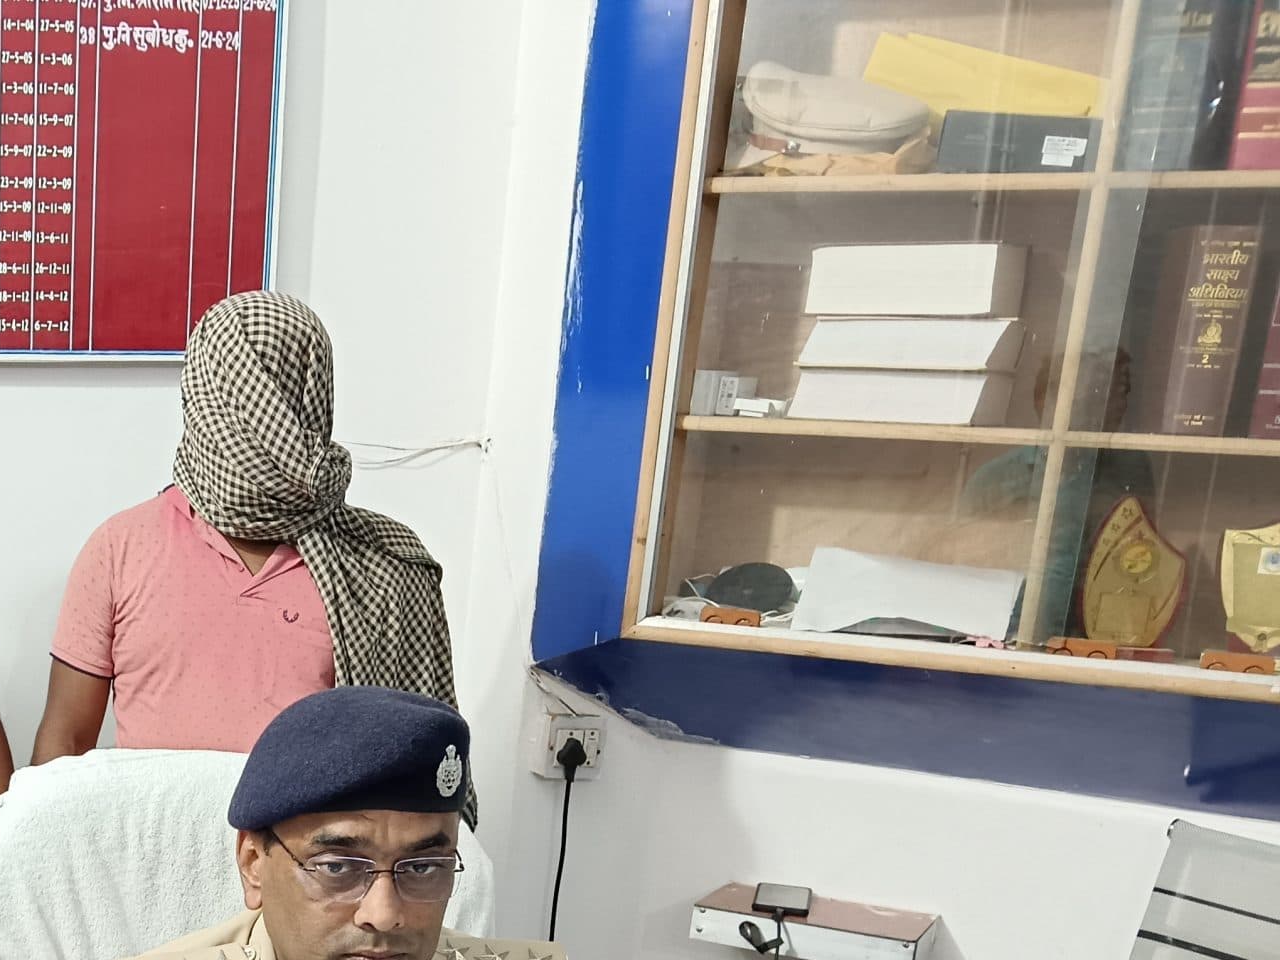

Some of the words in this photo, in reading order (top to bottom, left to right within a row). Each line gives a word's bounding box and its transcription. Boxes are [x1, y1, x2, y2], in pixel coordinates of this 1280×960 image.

[80, 26, 95, 45] 38
[1202, 249, 1249, 264] भारतीय
[1188, 283, 1248, 299] अधिनियम
